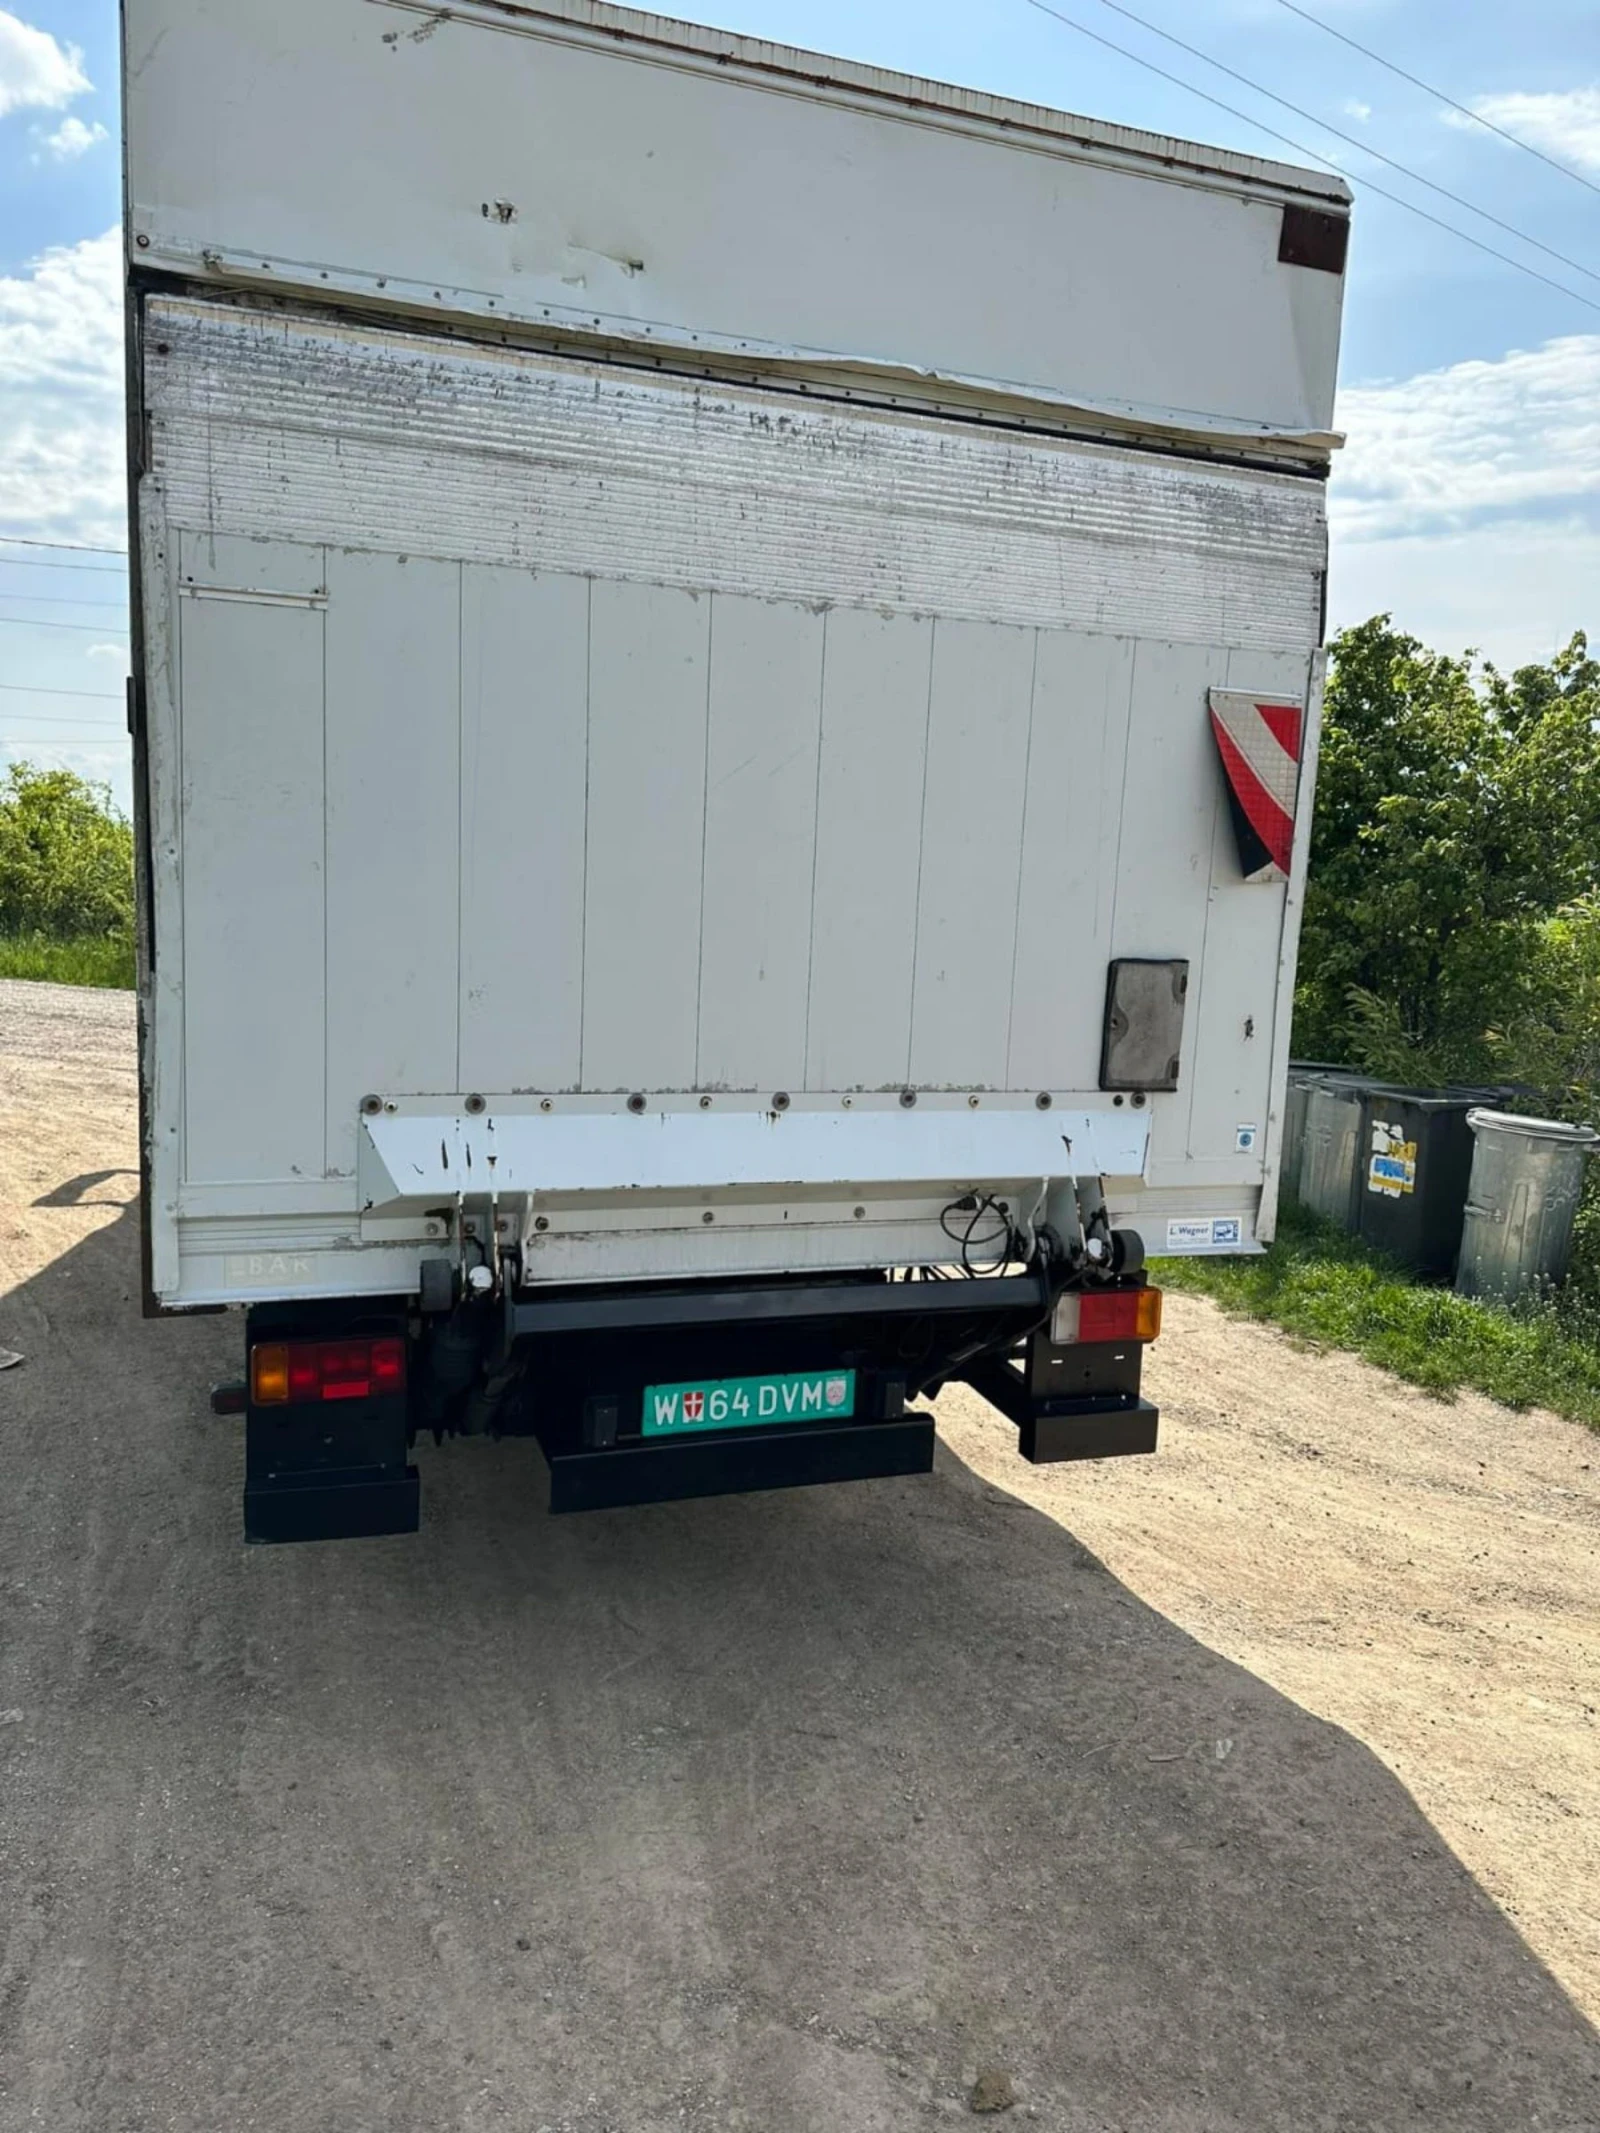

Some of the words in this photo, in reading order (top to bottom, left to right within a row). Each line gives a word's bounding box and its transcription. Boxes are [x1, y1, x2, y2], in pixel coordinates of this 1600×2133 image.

[654, 1393, 678, 1426] W
[709, 1387, 750, 1421] 64
[758, 1380, 823, 1416] DVM
